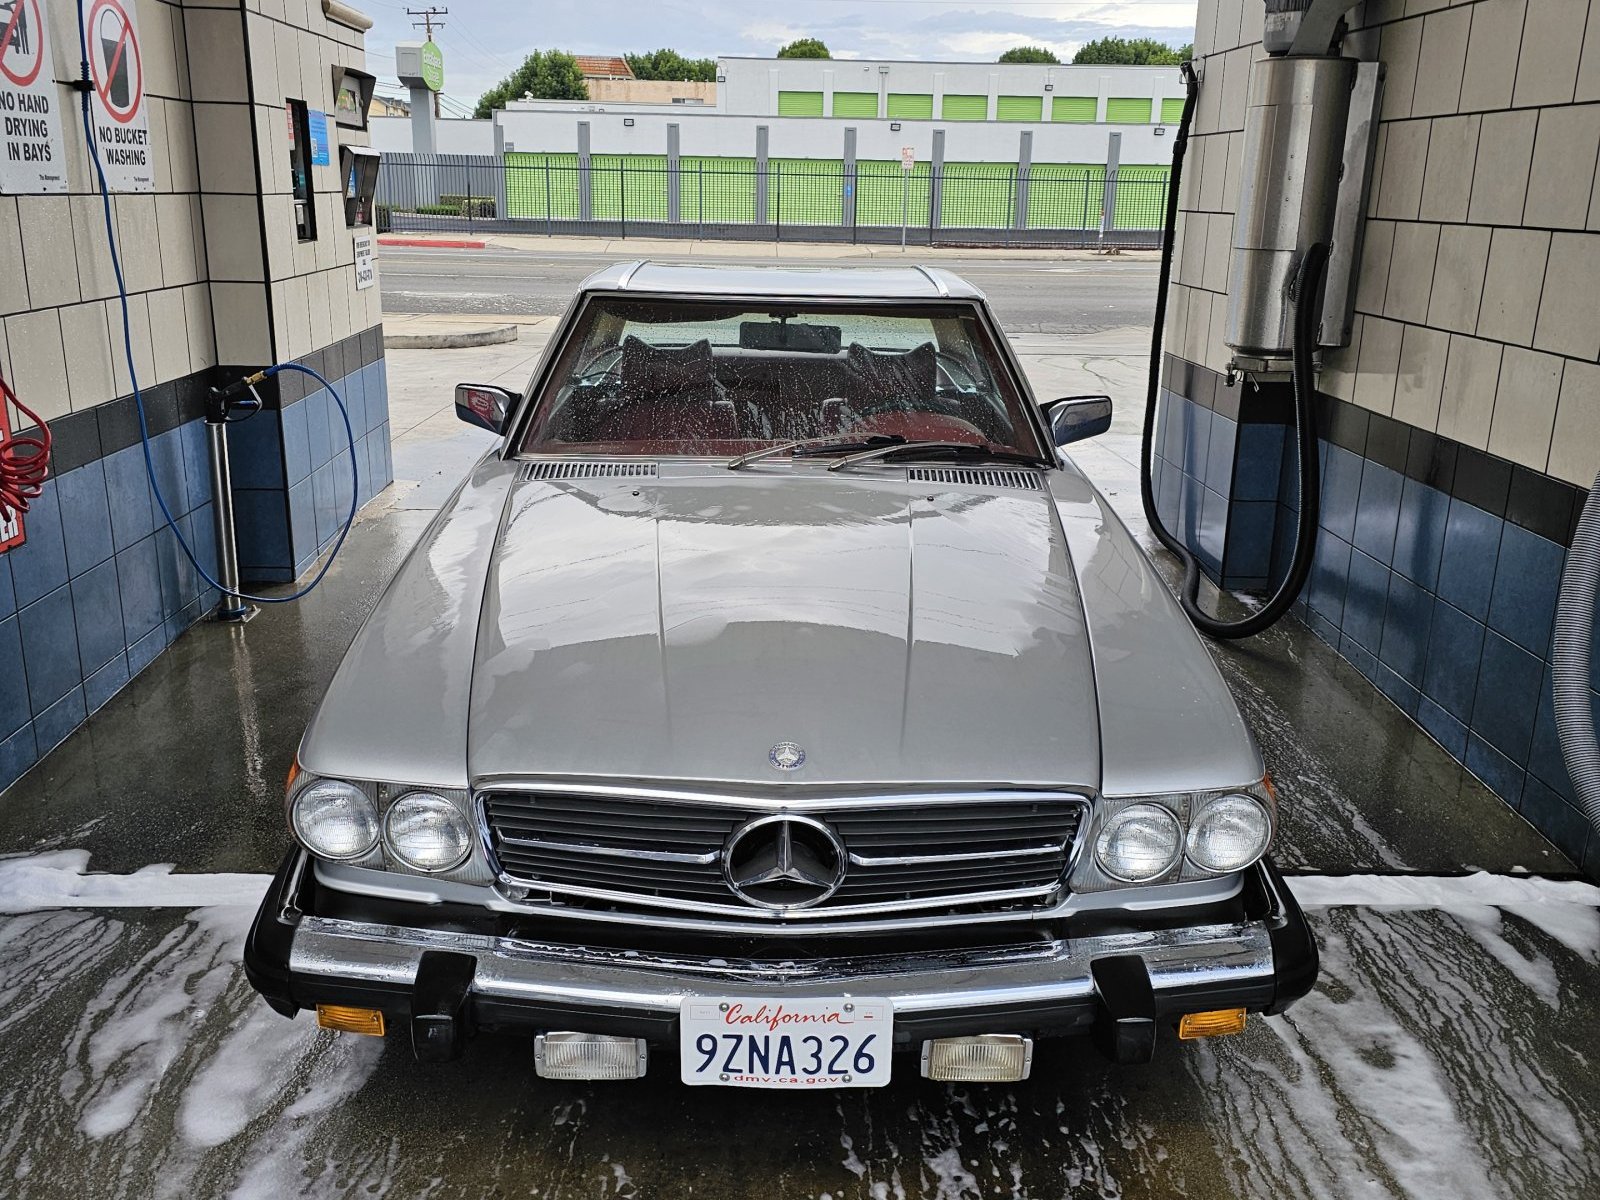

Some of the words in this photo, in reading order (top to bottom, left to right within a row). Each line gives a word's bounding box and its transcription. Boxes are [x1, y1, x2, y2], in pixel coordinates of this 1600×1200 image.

[0, 90, 15, 111] NO
[18, 93, 49, 115] HAND
[5, 117, 49, 138] DRYING
[99, 126, 113, 143] NO
[115, 128, 148, 145] BUCKET
[7, 142, 21, 161] IN
[23, 143, 52, 162] BAYS
[106, 148, 146, 166] WASHING
[725, 1003, 854, 1031] California
[696, 1033, 877, 1075] 9ZNA326
[734, 1075, 839, 1084] dmv.ca.gov
